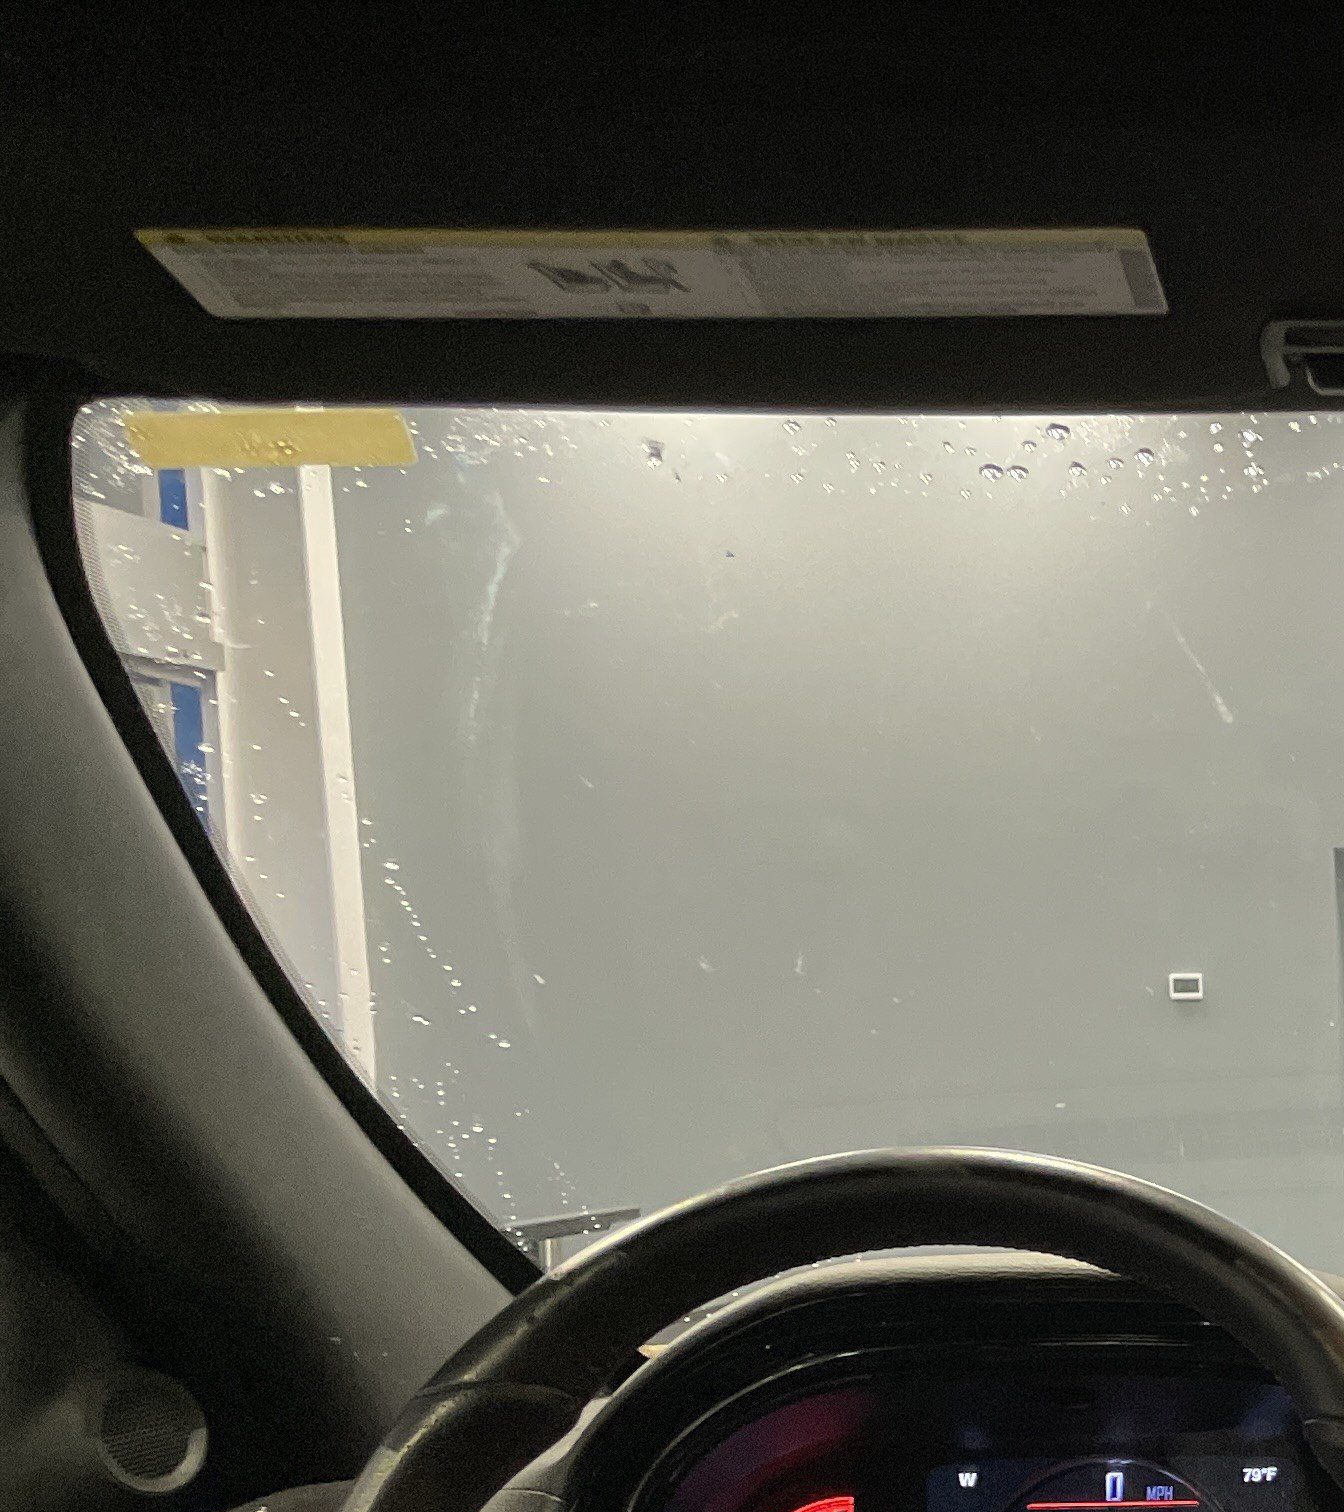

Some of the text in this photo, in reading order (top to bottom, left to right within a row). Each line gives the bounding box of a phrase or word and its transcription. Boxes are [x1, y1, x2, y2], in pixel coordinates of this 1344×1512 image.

[958, 1472, 978, 1487] W
[1105, 1471, 1174, 1501] 0 MPH
